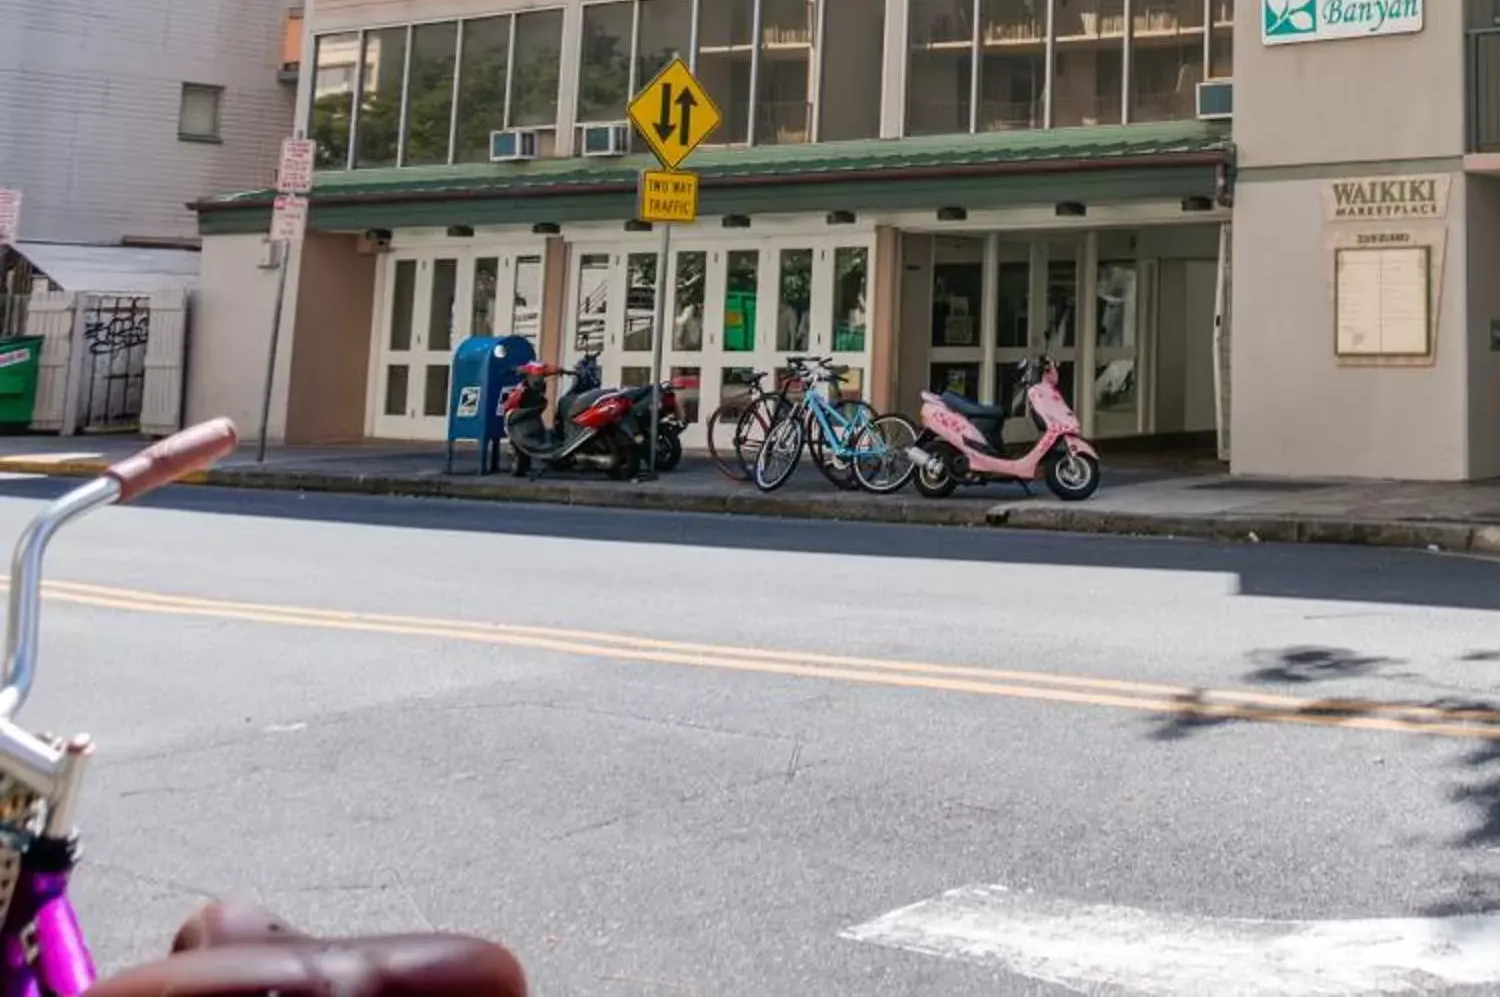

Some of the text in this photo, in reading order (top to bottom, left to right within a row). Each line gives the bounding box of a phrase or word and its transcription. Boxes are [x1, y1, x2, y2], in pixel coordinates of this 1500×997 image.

[648, 179, 693, 195] TWO WAY
[1333, 179, 1436, 205] WAIKIKI
[649, 198, 691, 215] TRAFFIC
[1335, 204, 1437, 216] MARKETPLACE
